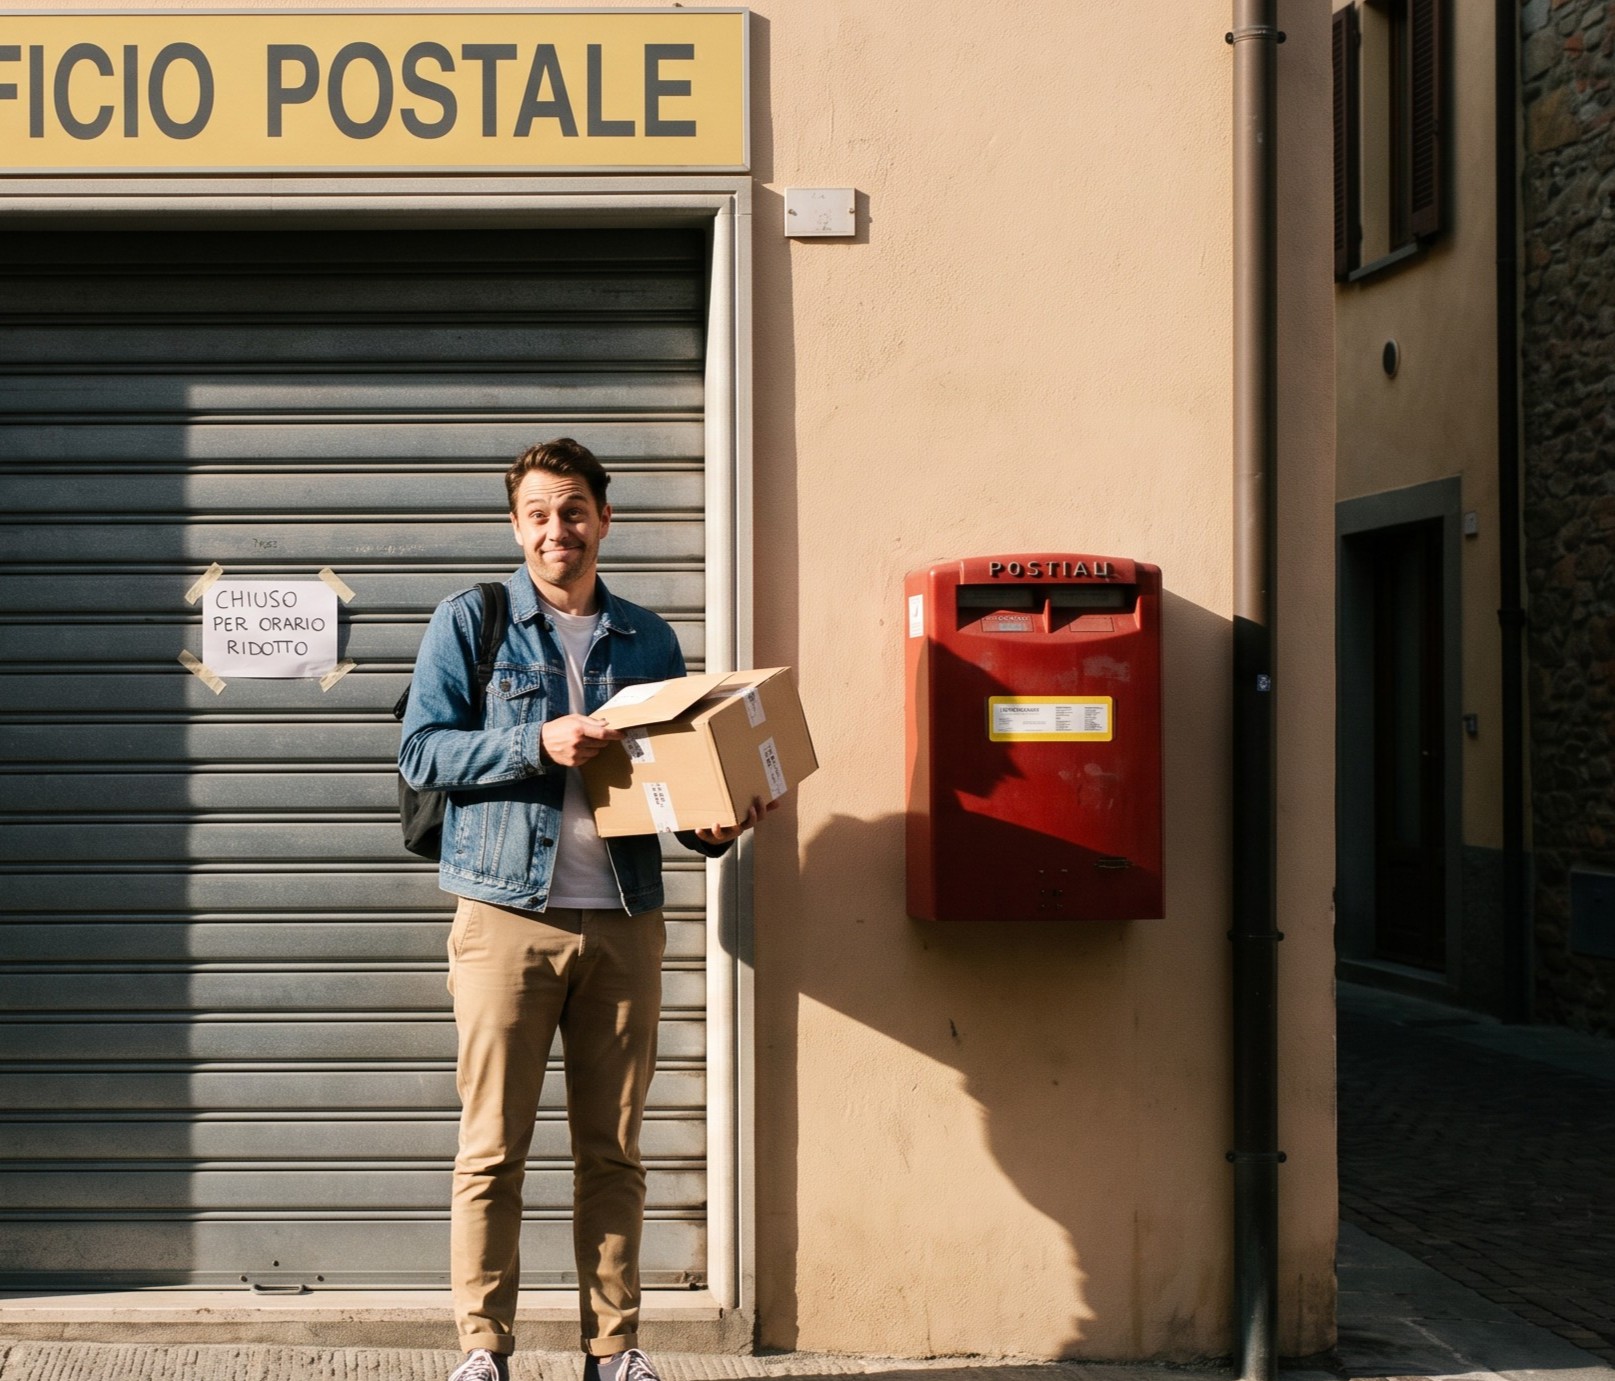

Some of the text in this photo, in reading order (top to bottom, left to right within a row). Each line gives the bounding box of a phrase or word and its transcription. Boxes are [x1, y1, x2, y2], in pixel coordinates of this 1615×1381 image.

[266, 42, 697, 140] POSTALE
[215, 589, 298, 610] CHIUSO
[213, 616, 326, 632] PER ORARIO
[226, 639, 309, 656] RIDOTTO
